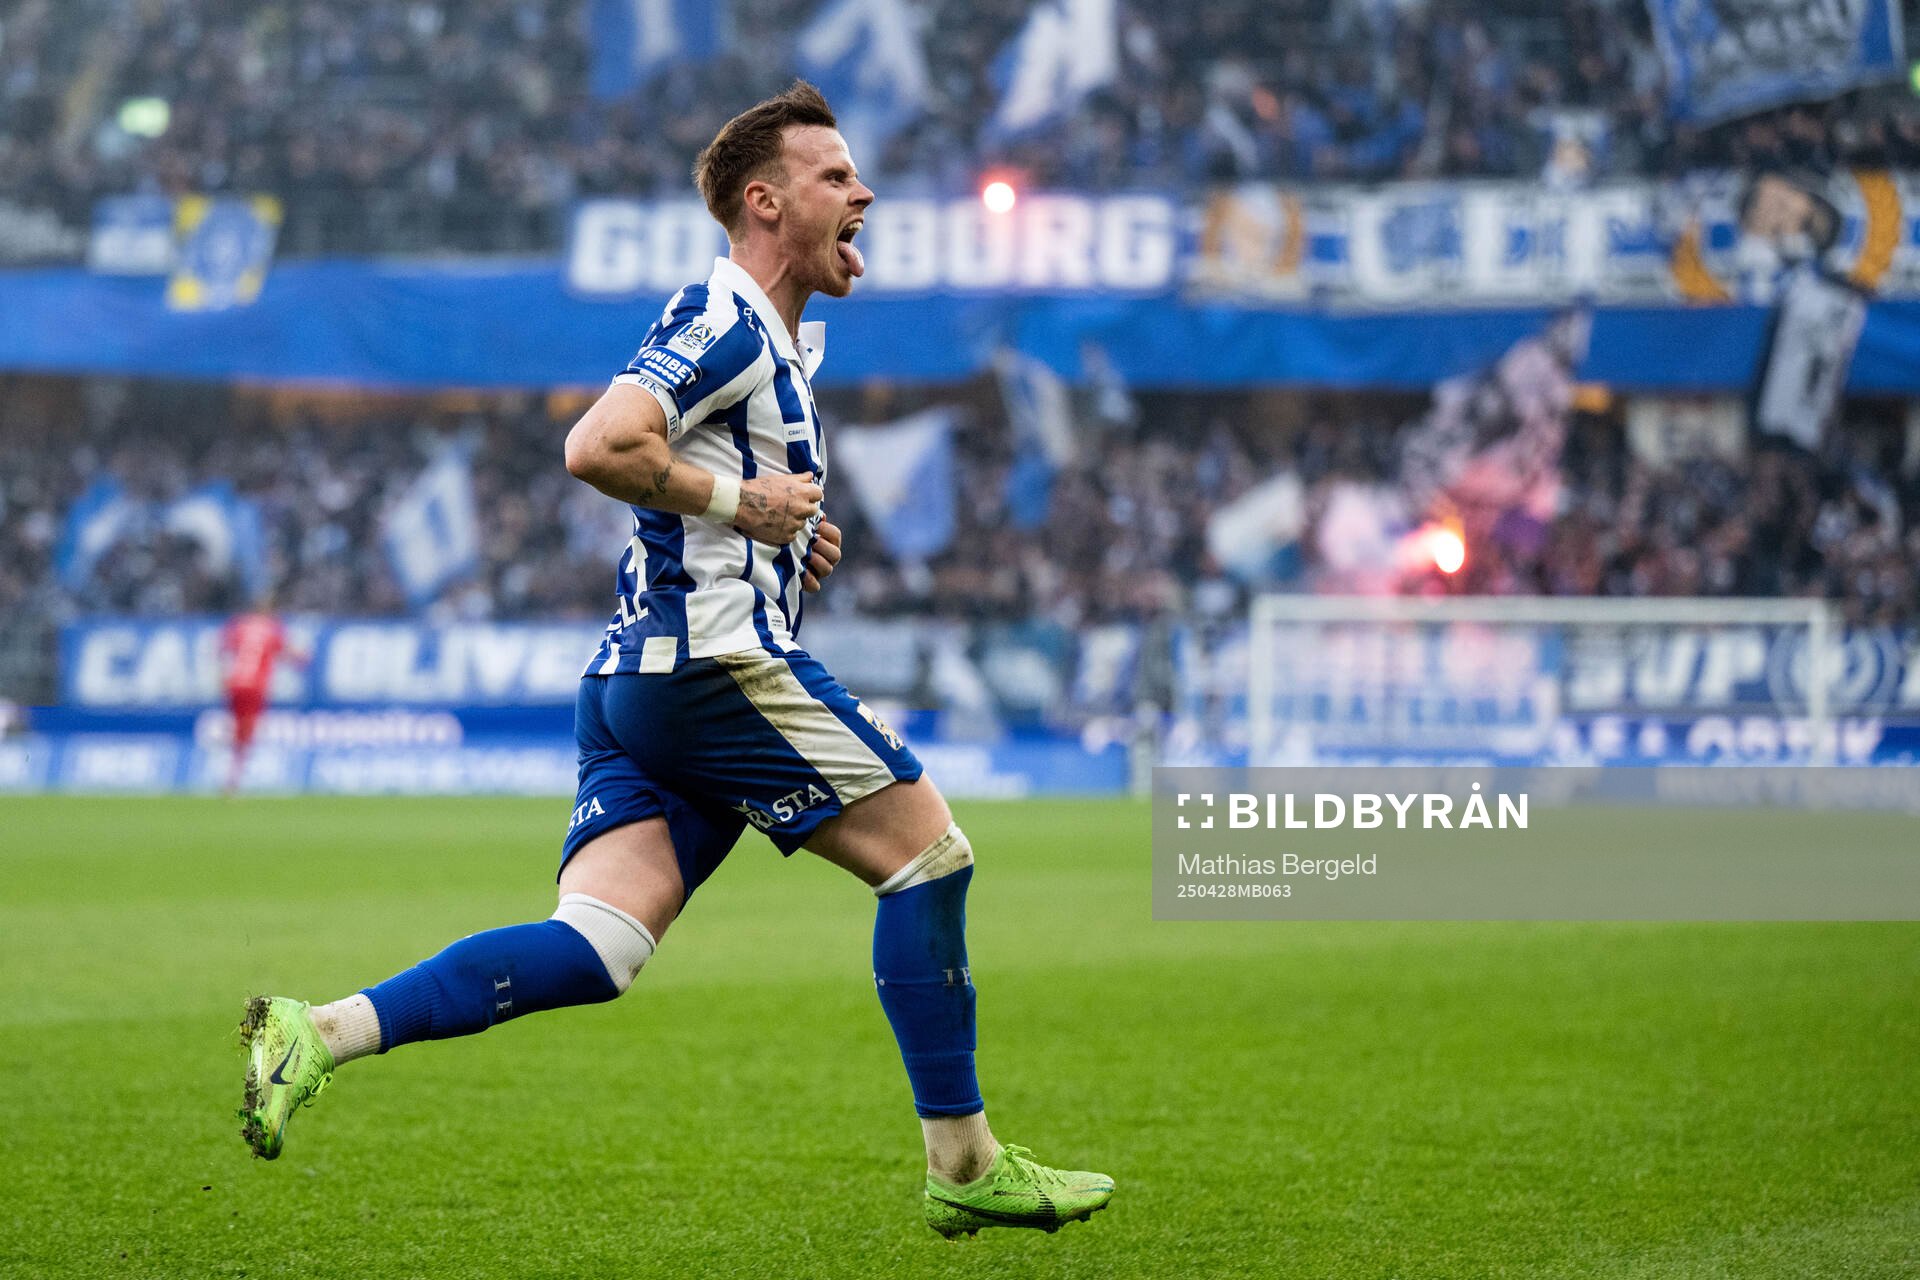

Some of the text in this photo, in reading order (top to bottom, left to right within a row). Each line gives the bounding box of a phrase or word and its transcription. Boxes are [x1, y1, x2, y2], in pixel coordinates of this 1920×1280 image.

[569, 197, 1175, 293] GOBORG
[642, 350, 697, 386] UNIBET
[638, 377, 661, 395] IFK
[669, 415, 678, 437] IFK
